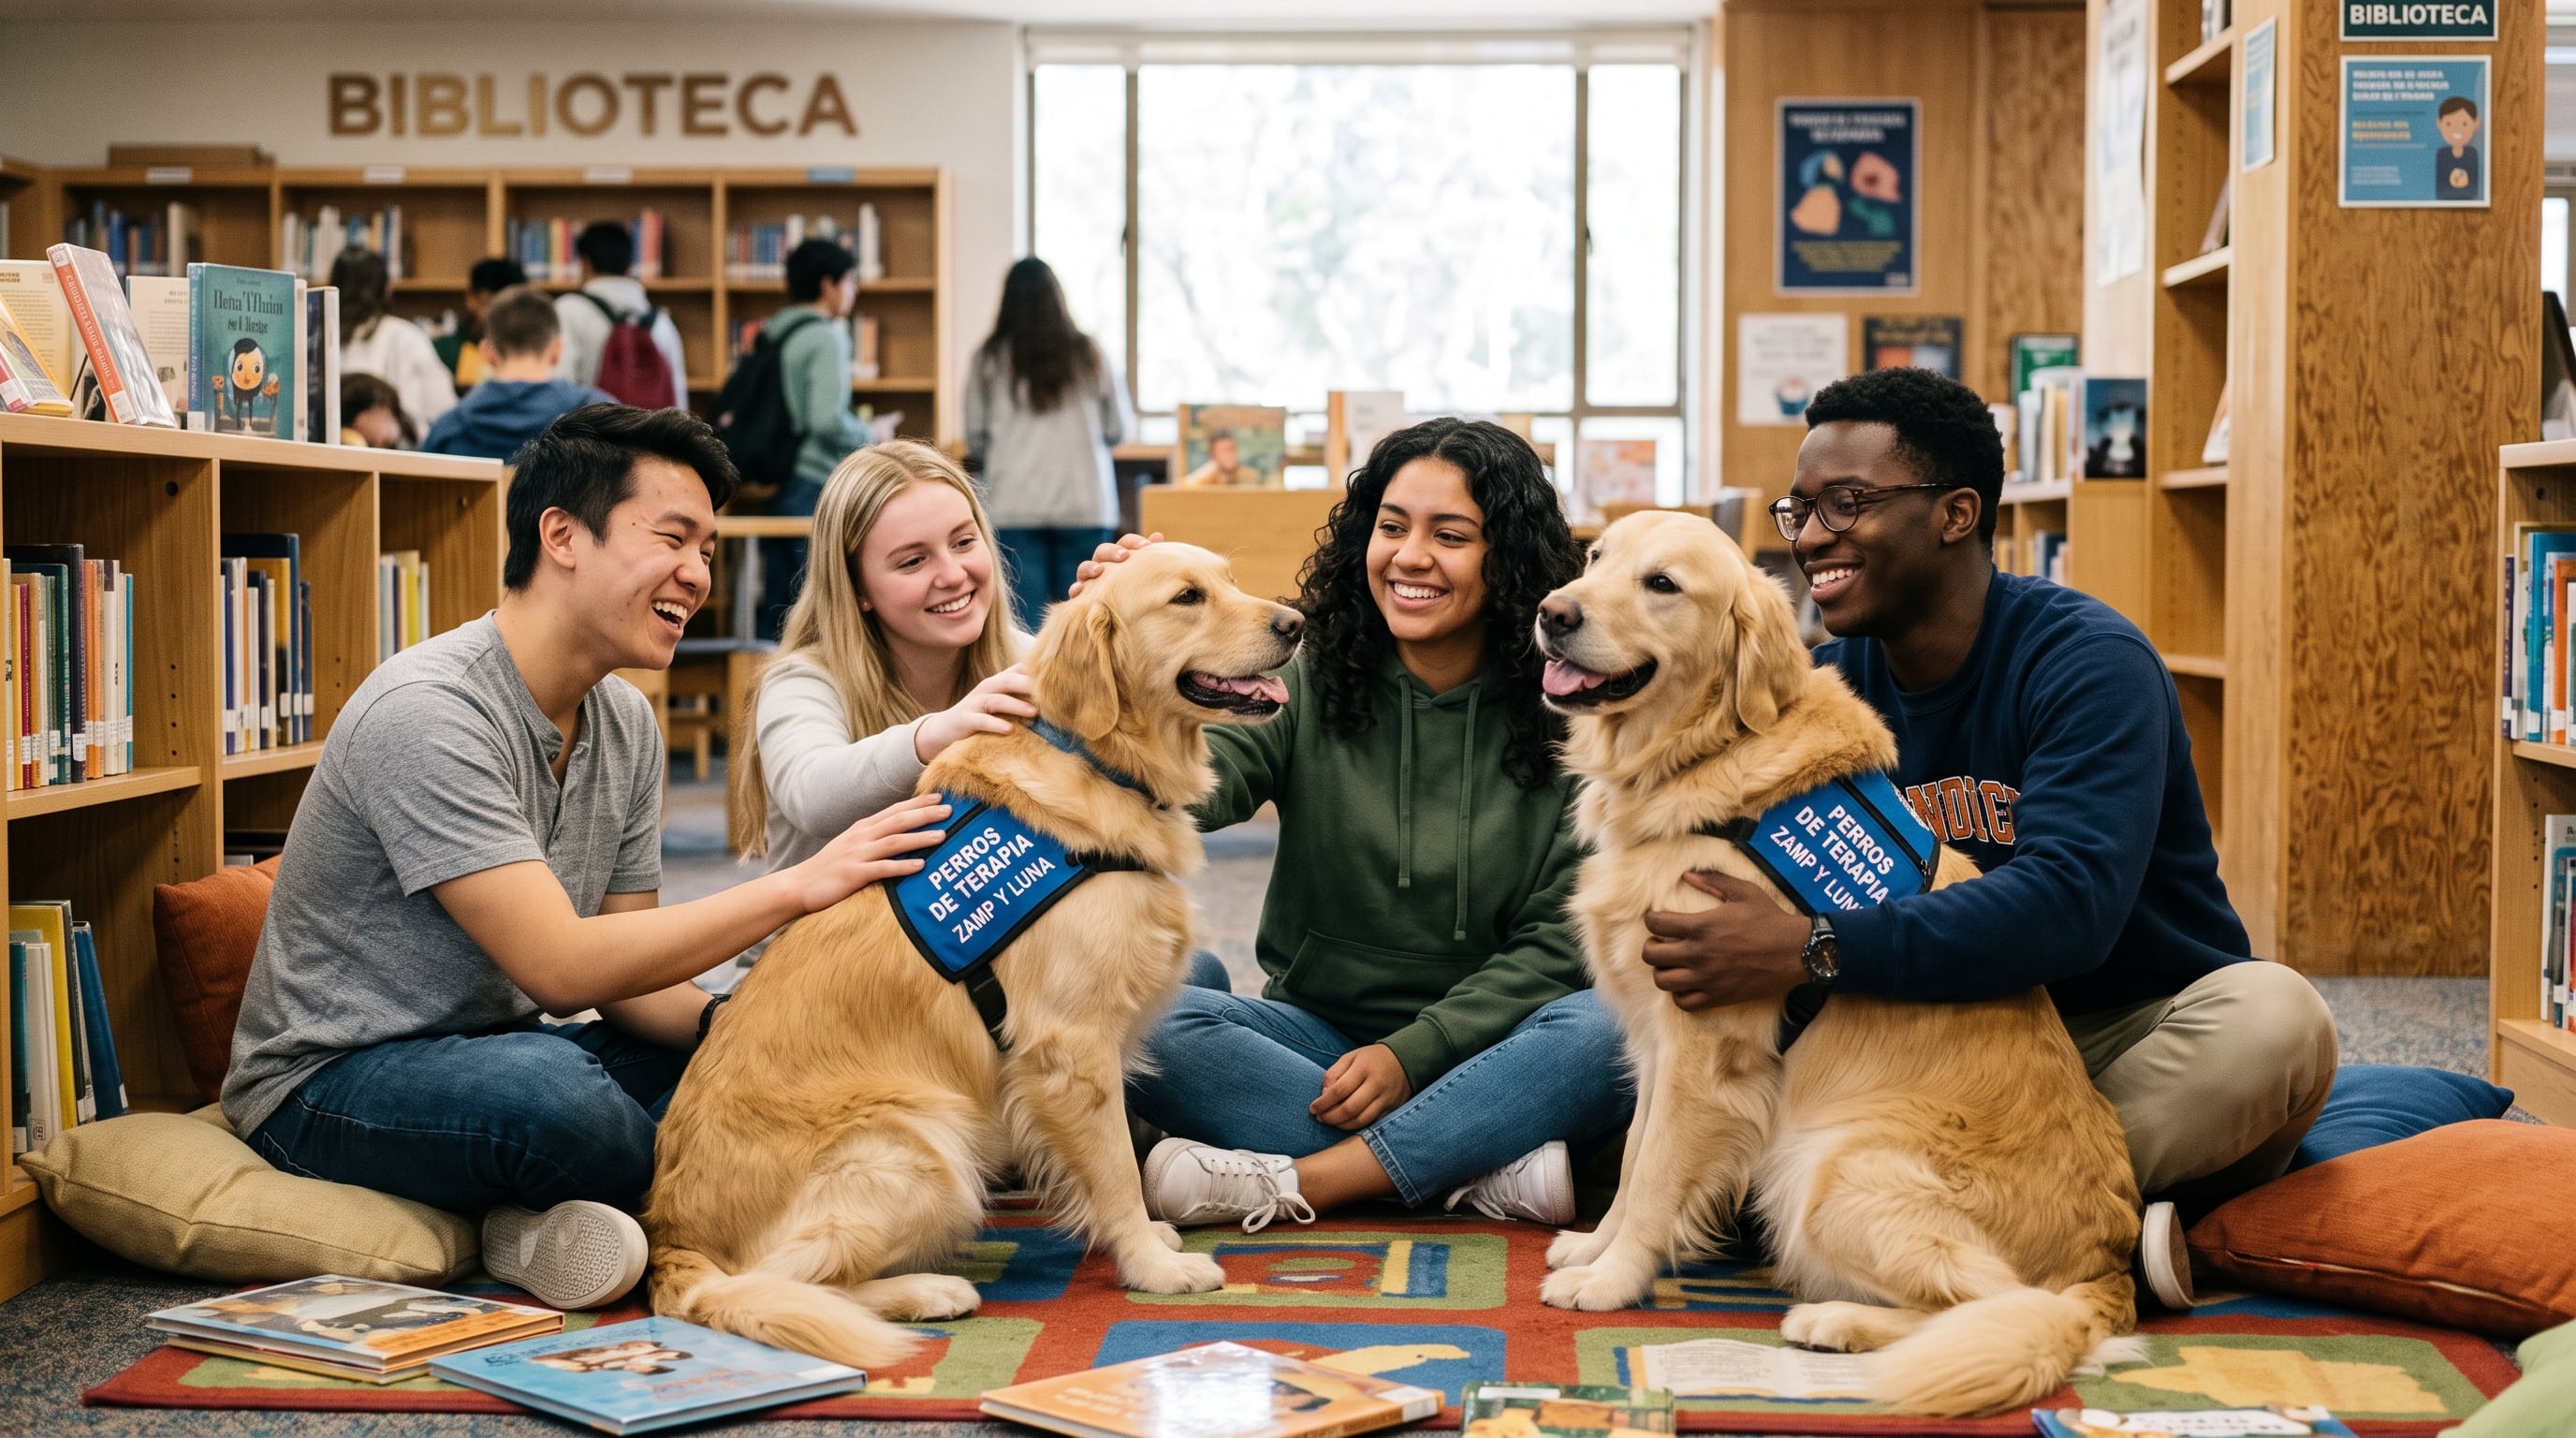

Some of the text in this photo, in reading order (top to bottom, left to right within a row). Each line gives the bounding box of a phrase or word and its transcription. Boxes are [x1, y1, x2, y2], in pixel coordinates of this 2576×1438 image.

[2349, 4, 2488, 24] BIBLIOTECA
[328, 71, 858, 139] BIBLIOTECA
[928, 826, 1002, 891] PERROS
[928, 834, 1034, 922] DE TERAPIA
[1770, 825, 1864, 911] ZAMP Y LUN
[1794, 805, 1890, 905] DE TERAPIA
[1827, 804, 1895, 875] PERROS
[951, 856, 1056, 944] ZAMP Y LUNA
